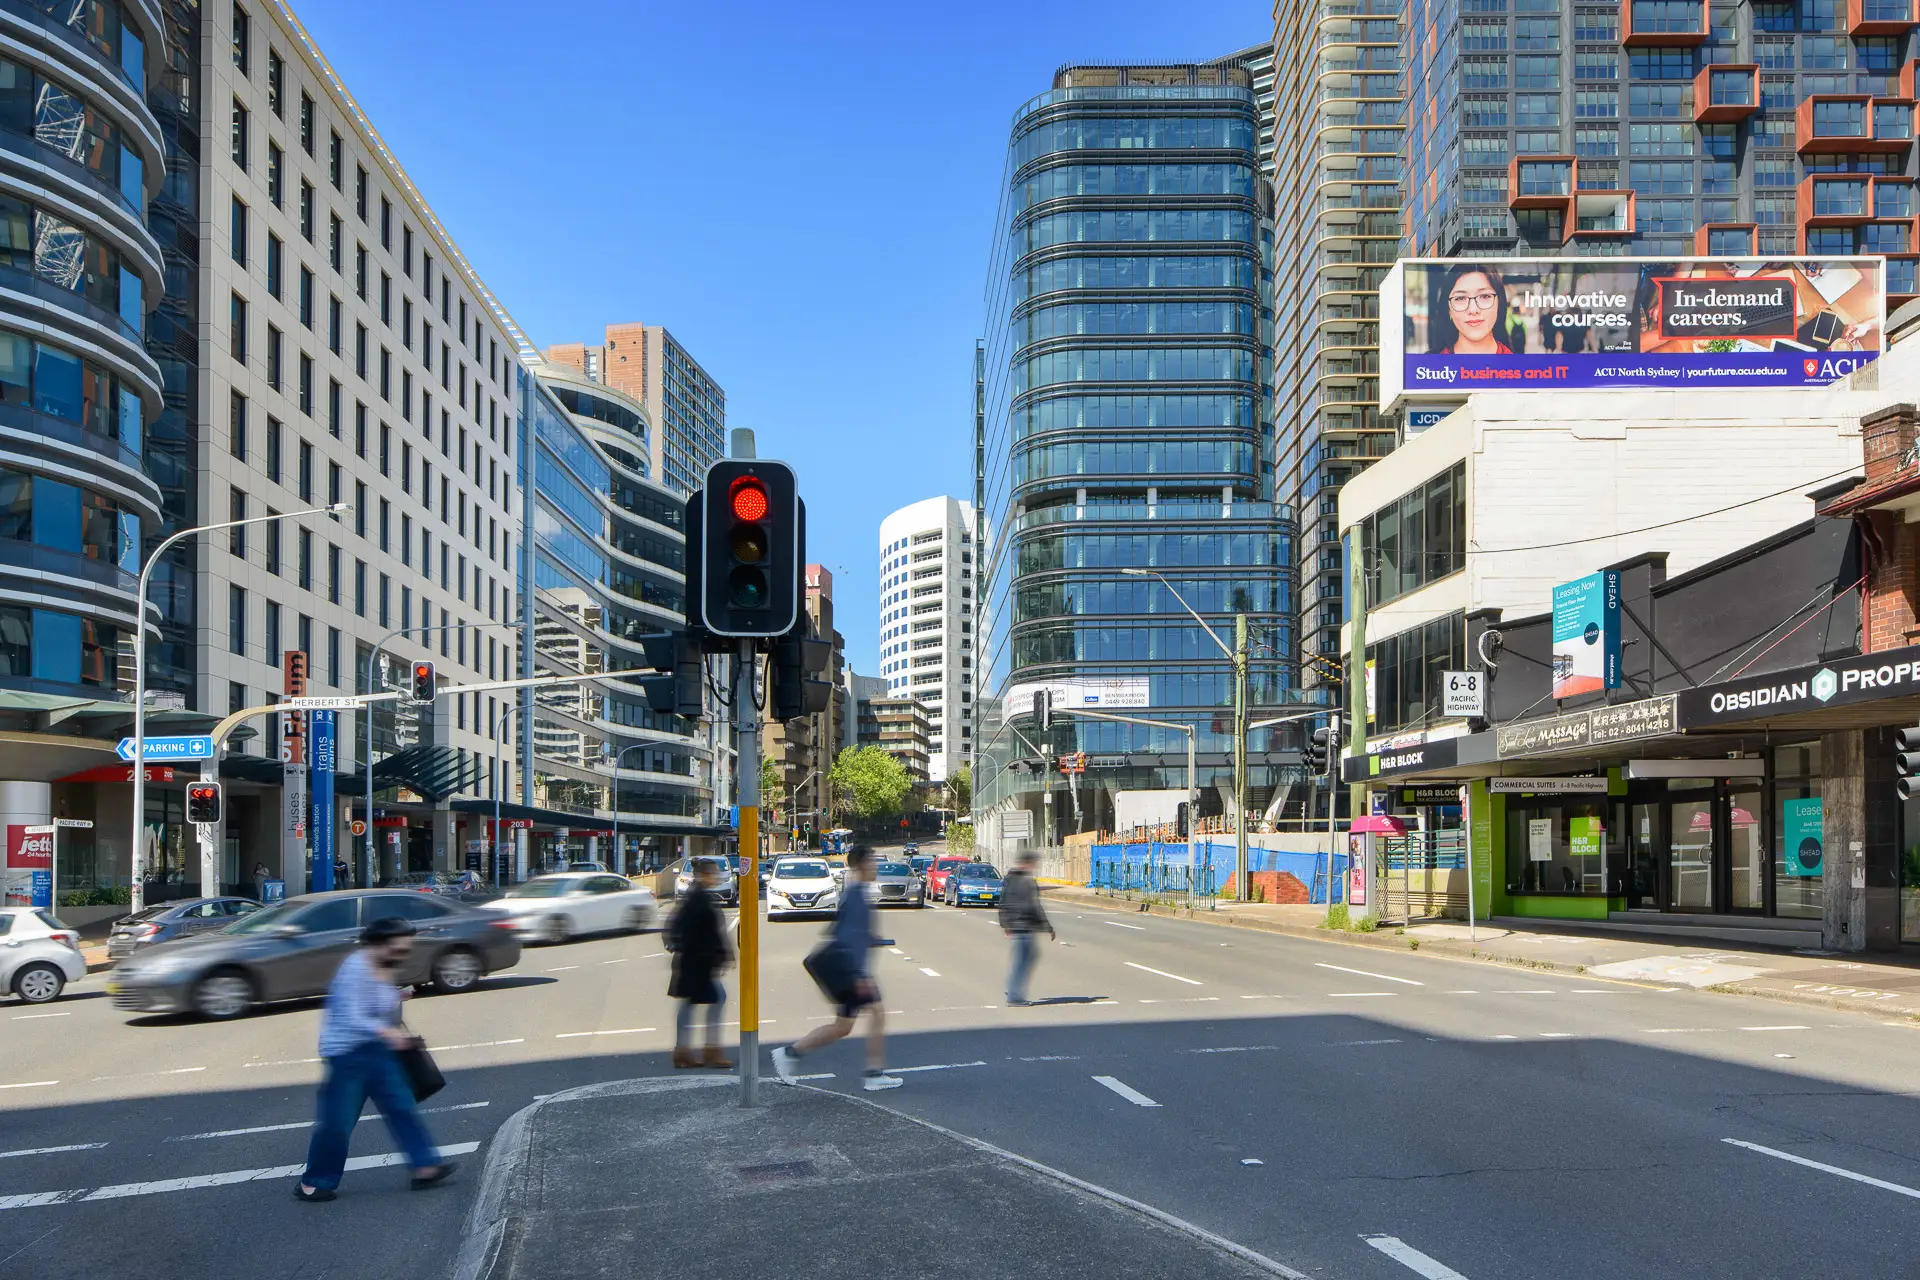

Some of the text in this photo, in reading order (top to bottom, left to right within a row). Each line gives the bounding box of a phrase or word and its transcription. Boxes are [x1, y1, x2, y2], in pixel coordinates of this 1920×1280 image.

[1524, 290, 1627, 308] Innovative
[1674, 288, 1784, 307] In-demand
[1551, 312, 1632, 327] courses.
[1669, 310, 1747, 327] careers.
[1415, 366, 1569, 383] Study business and IT
[1594, 367, 1680, 379] ACU North Sydney
[1687, 366, 1787, 378] yourfuture.acu.edu.au
[1555, 580, 1597, 600] Leasing Now
[1608, 573, 1617, 609] SHEAD
[1584, 629, 1599, 638] SHEAD
[1450, 675, 1477, 691] 6-8
[284, 654, 303, 738] Foum
[294, 698, 357, 707] HERBERT ST
[1710, 681, 1808, 713] OBSIDIAN
[1538, 722, 1587, 740] MASSAGE
[1593, 730, 1607, 740] Tel:
[1608, 727, 1619, 737] 02
[1625, 721, 1646, 735] 8041
[1647, 718, 1669, 730] 4218
[143, 743, 185, 753] PARKING
[318, 736, 328, 772] trains
[327, 738, 335, 773] trains
[1380, 751, 1424, 769] H&R BLOCK
[126, 769, 152, 782] 25
[163, 770, 173, 778] 205
[1416, 789, 1434, 797] H&R
[1494, 781, 1535, 789] COMMERCIAL
[1536, 781, 1556, 789] SUITES
[1585, 782, 1604, 790] Highway
[288, 792, 300, 831] buses
[312, 803, 320, 826] station
[312, 826, 320, 853] leonards
[1571, 837, 1588, 845] H&R
[1571, 845, 1598, 853] BLOCK
[1799, 849, 1821, 857] SHEAD
